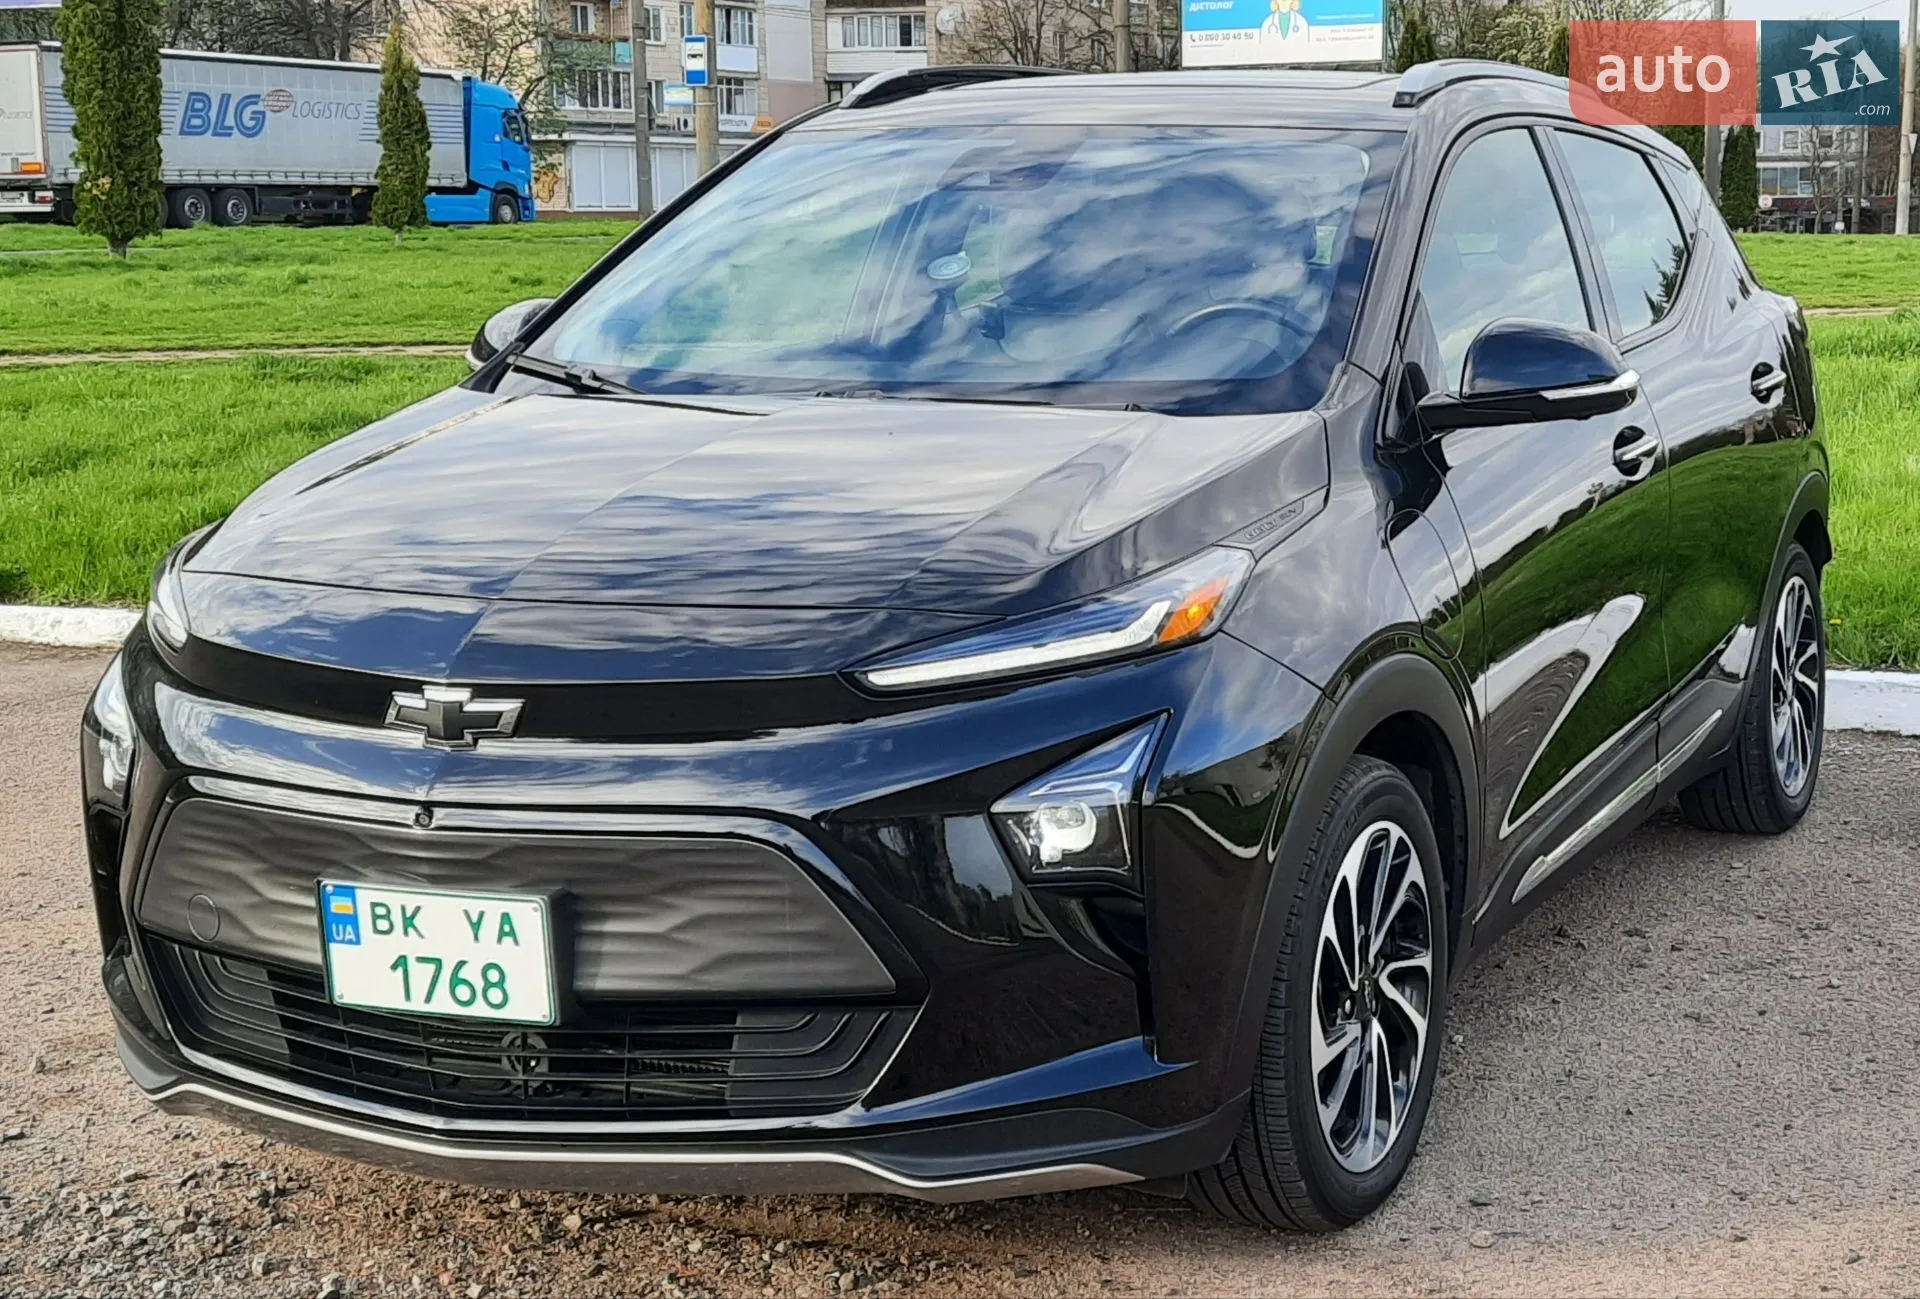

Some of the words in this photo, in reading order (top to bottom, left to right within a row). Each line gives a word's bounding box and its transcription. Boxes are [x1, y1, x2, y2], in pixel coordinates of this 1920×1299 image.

[179, 91, 266, 138] BLG
[292, 100, 362, 120] LOGISTICS
[332, 923, 356, 943] UA
[369, 901, 425, 939] BK
[463, 909, 520, 946] YA
[390, 954, 508, 1010] 1768
